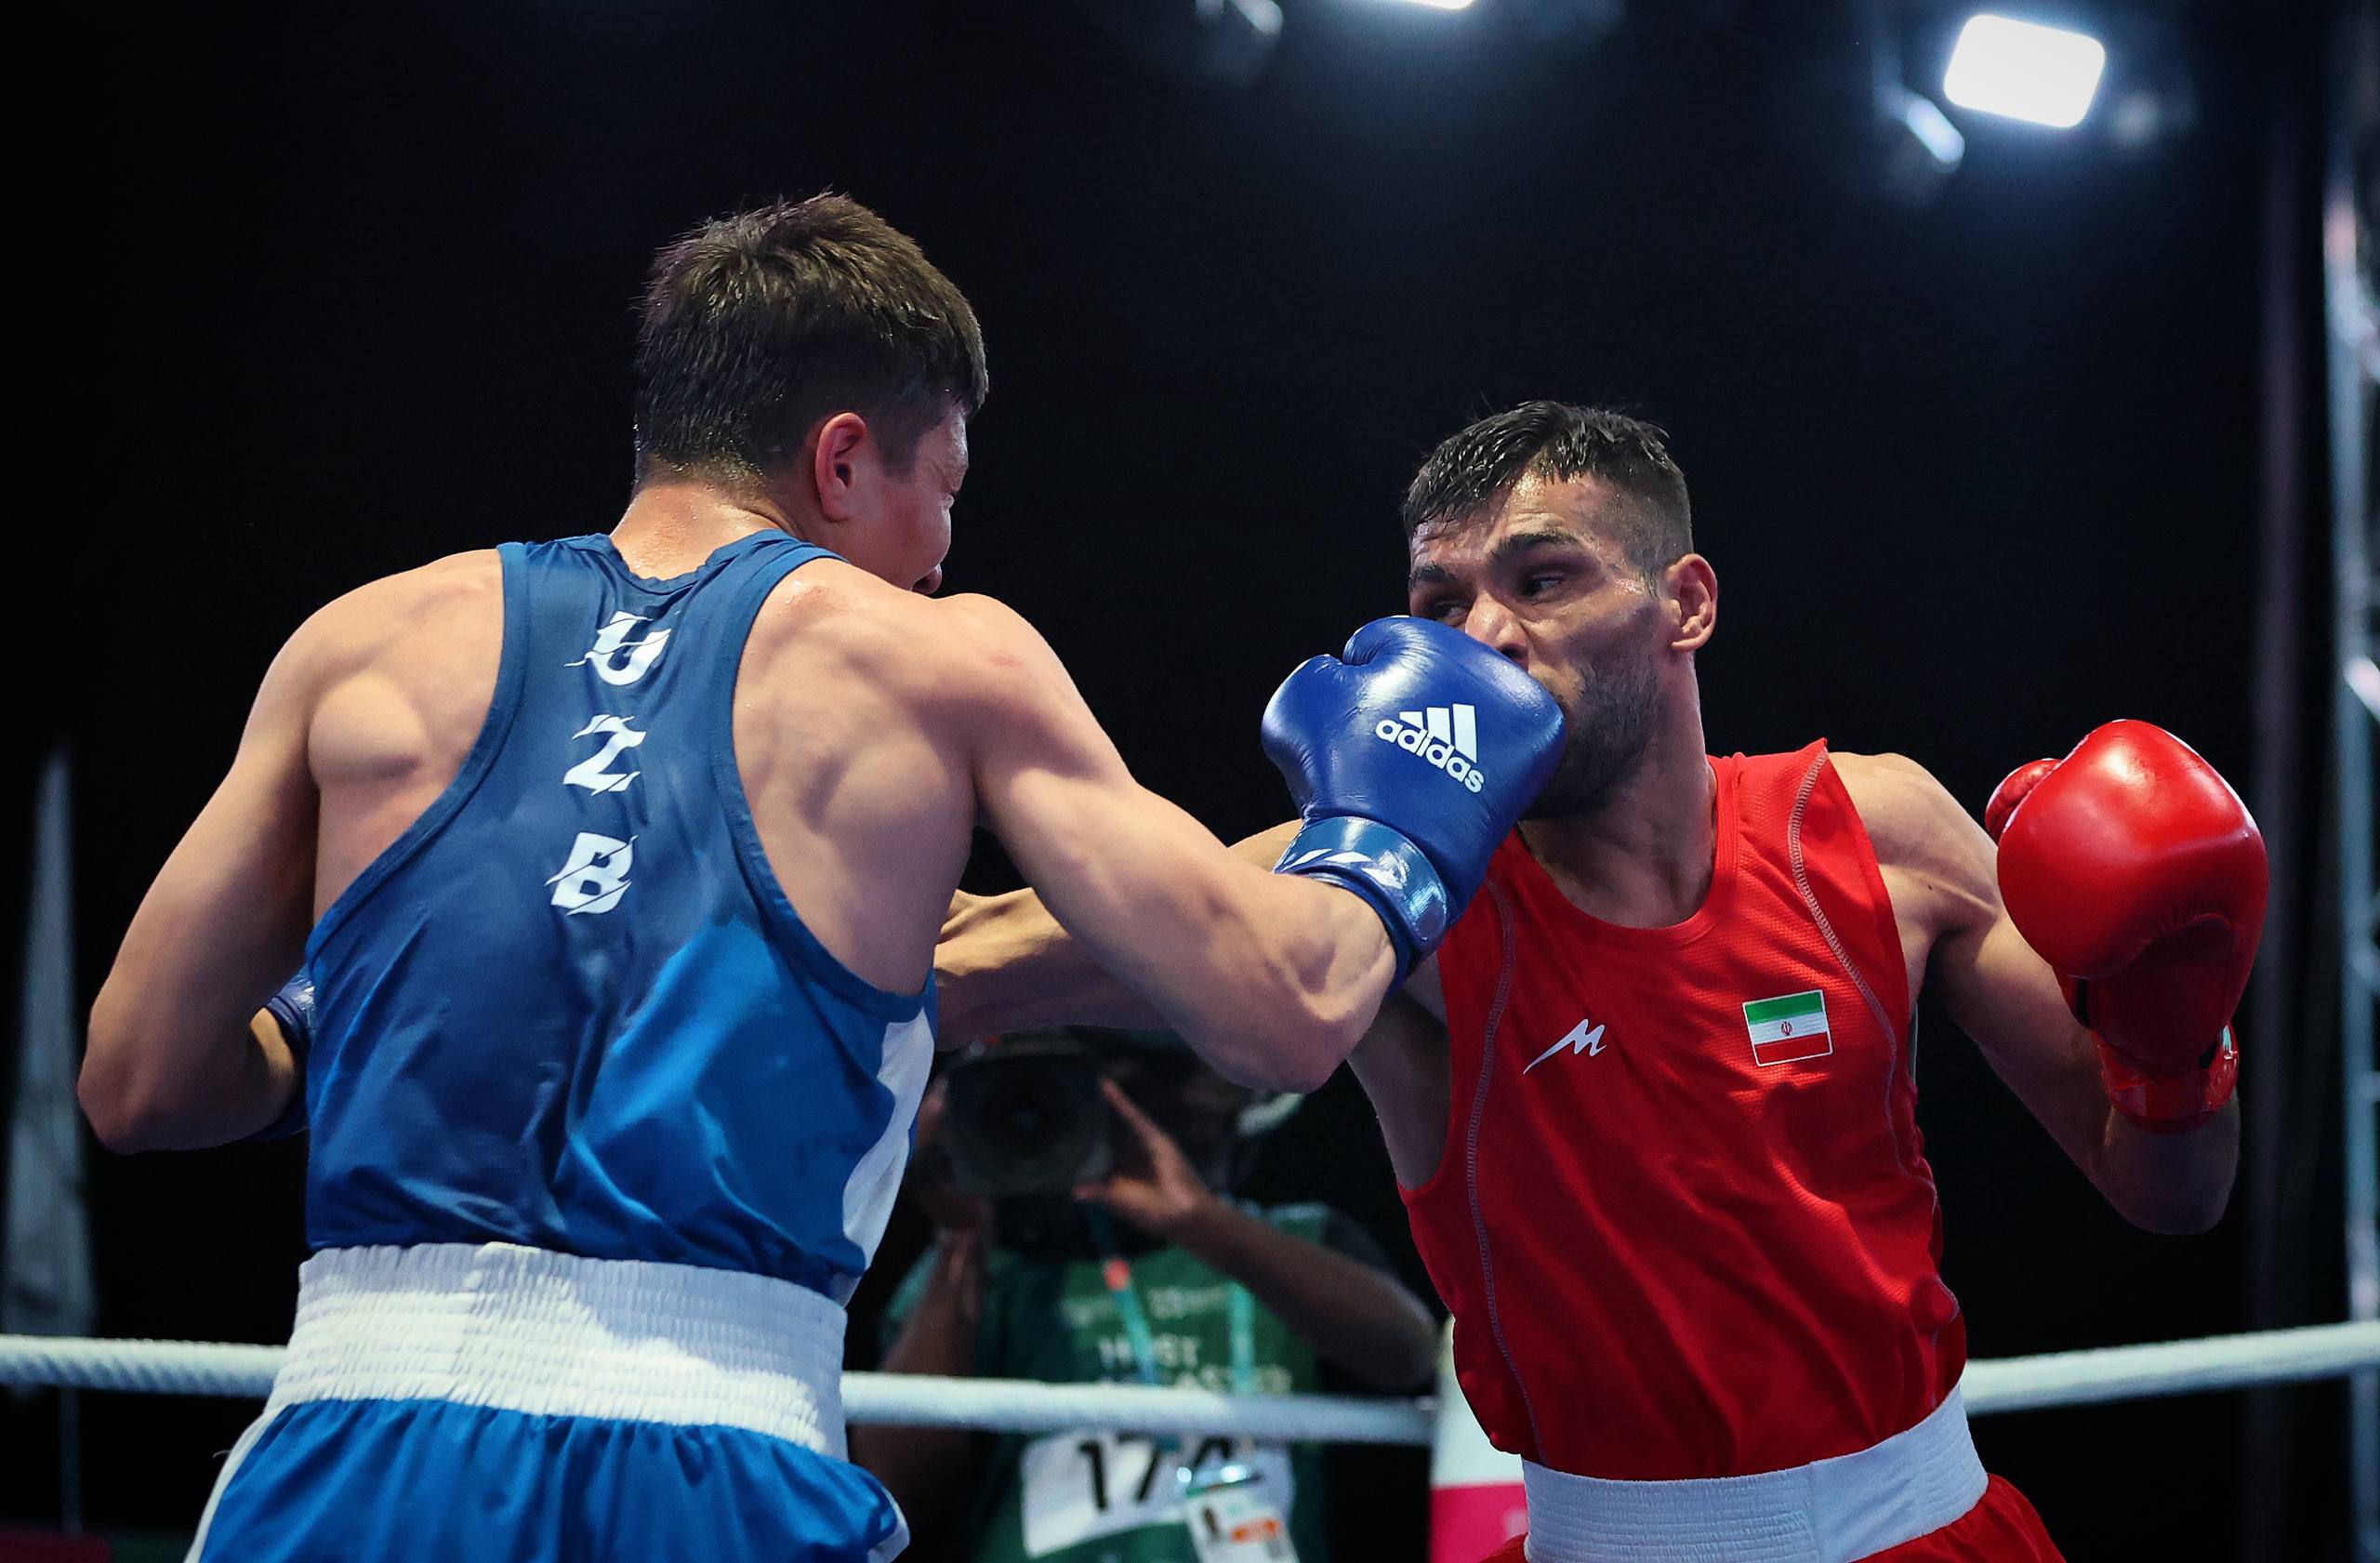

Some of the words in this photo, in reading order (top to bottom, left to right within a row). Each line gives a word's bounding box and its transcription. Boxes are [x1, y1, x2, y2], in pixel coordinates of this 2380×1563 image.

[545, 611, 672, 916] UZB
[1375, 719, 1485, 793] adidas
[1098, 1335, 1199, 1368] HST
